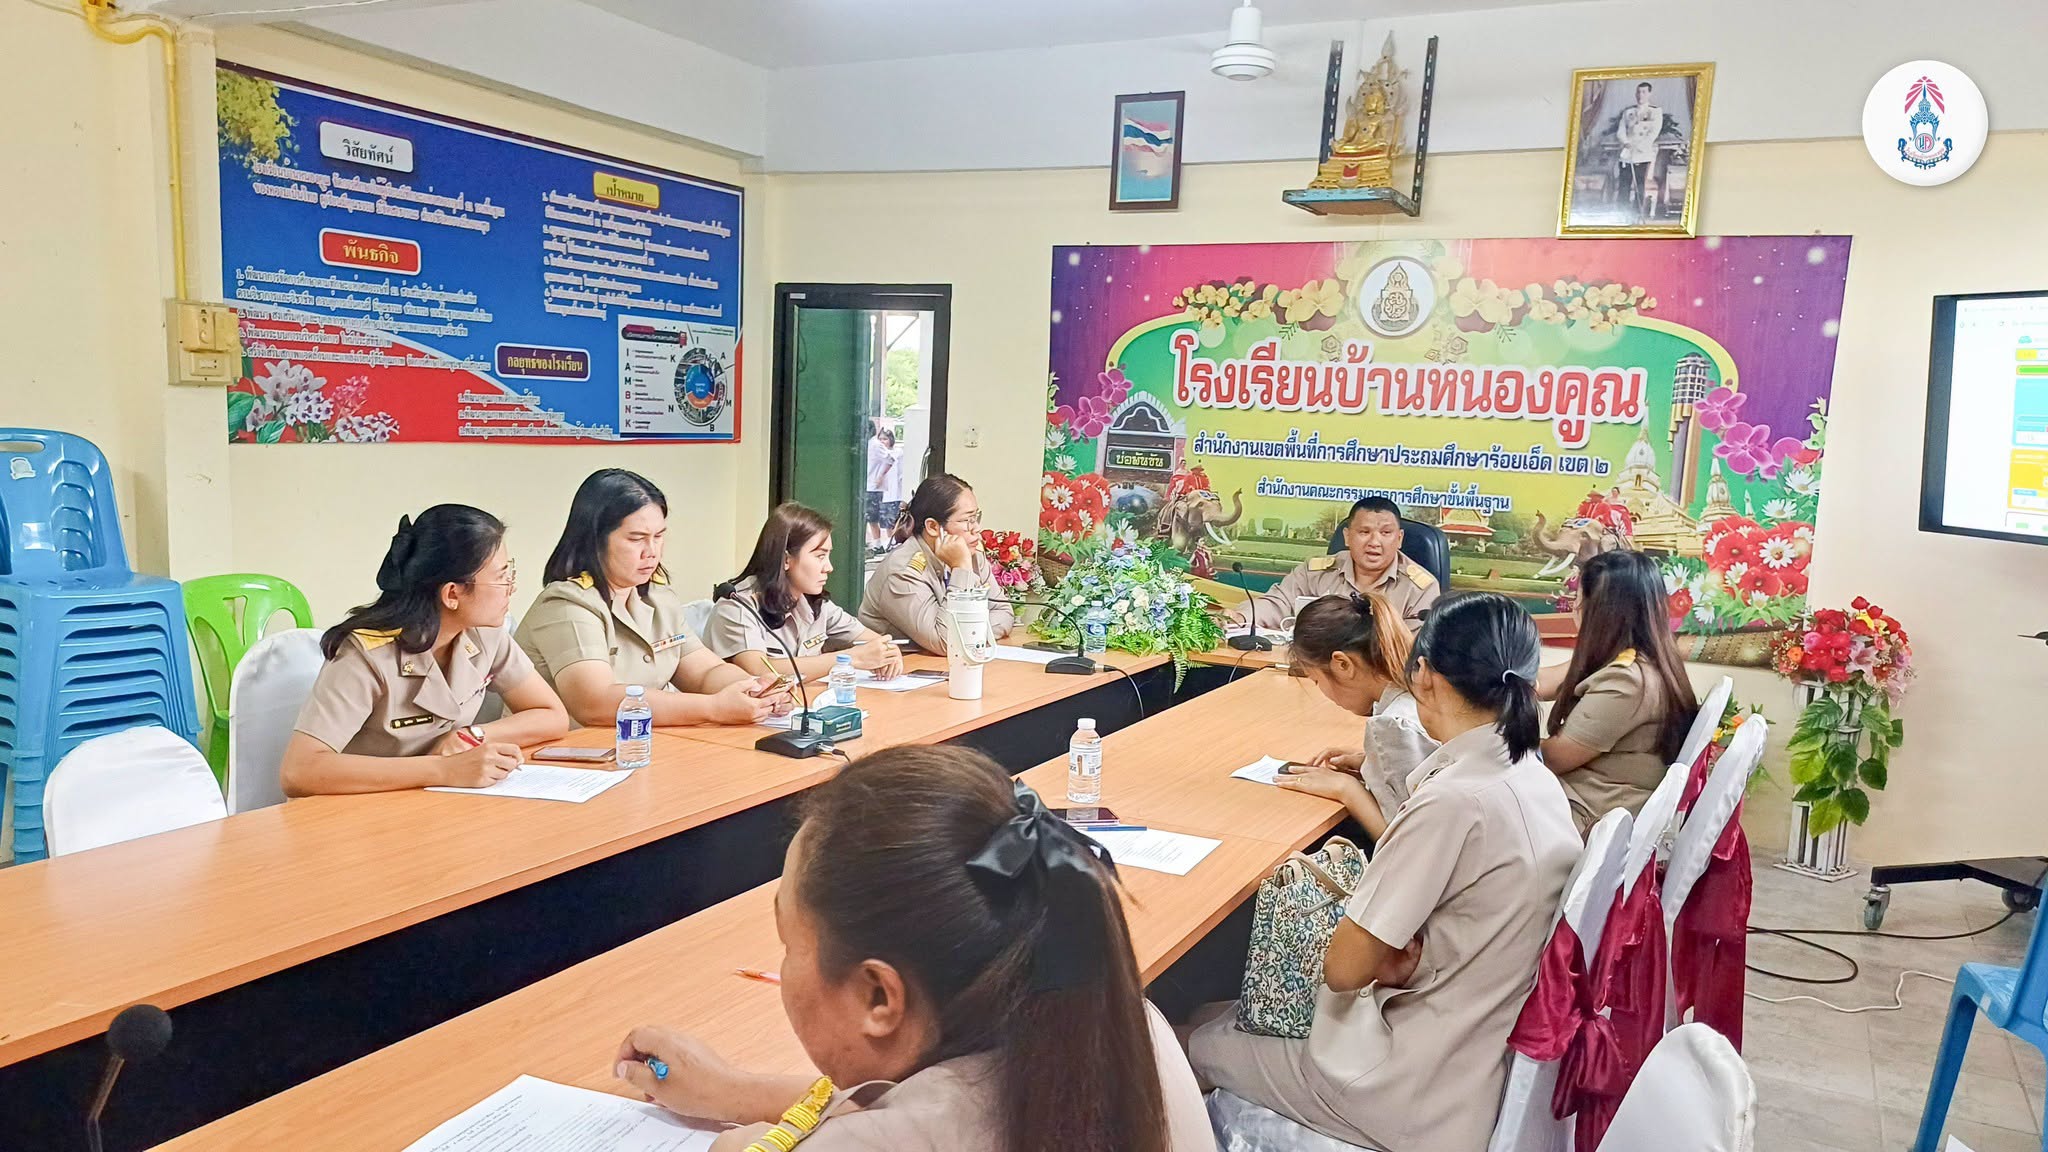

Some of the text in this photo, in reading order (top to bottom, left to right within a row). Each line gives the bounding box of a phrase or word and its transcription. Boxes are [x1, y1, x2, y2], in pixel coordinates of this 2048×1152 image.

[342, 138, 394, 165] วิสัยทัศน์
[343, 239, 399, 264] พันธกิจ
[507, 349, 583, 375] กลยุทธ์ของโรงเรียน
[1172, 332, 1643, 444] โรงเรียนบ้านหนองคูณ
[1116, 451, 1164, 468] บ่อพันขัน
[1194, 430, 1609, 474] สำนักงานเขตพื้นที่การศึกษาประถมศึกษาร้อยเอ็ด เขต ๒
